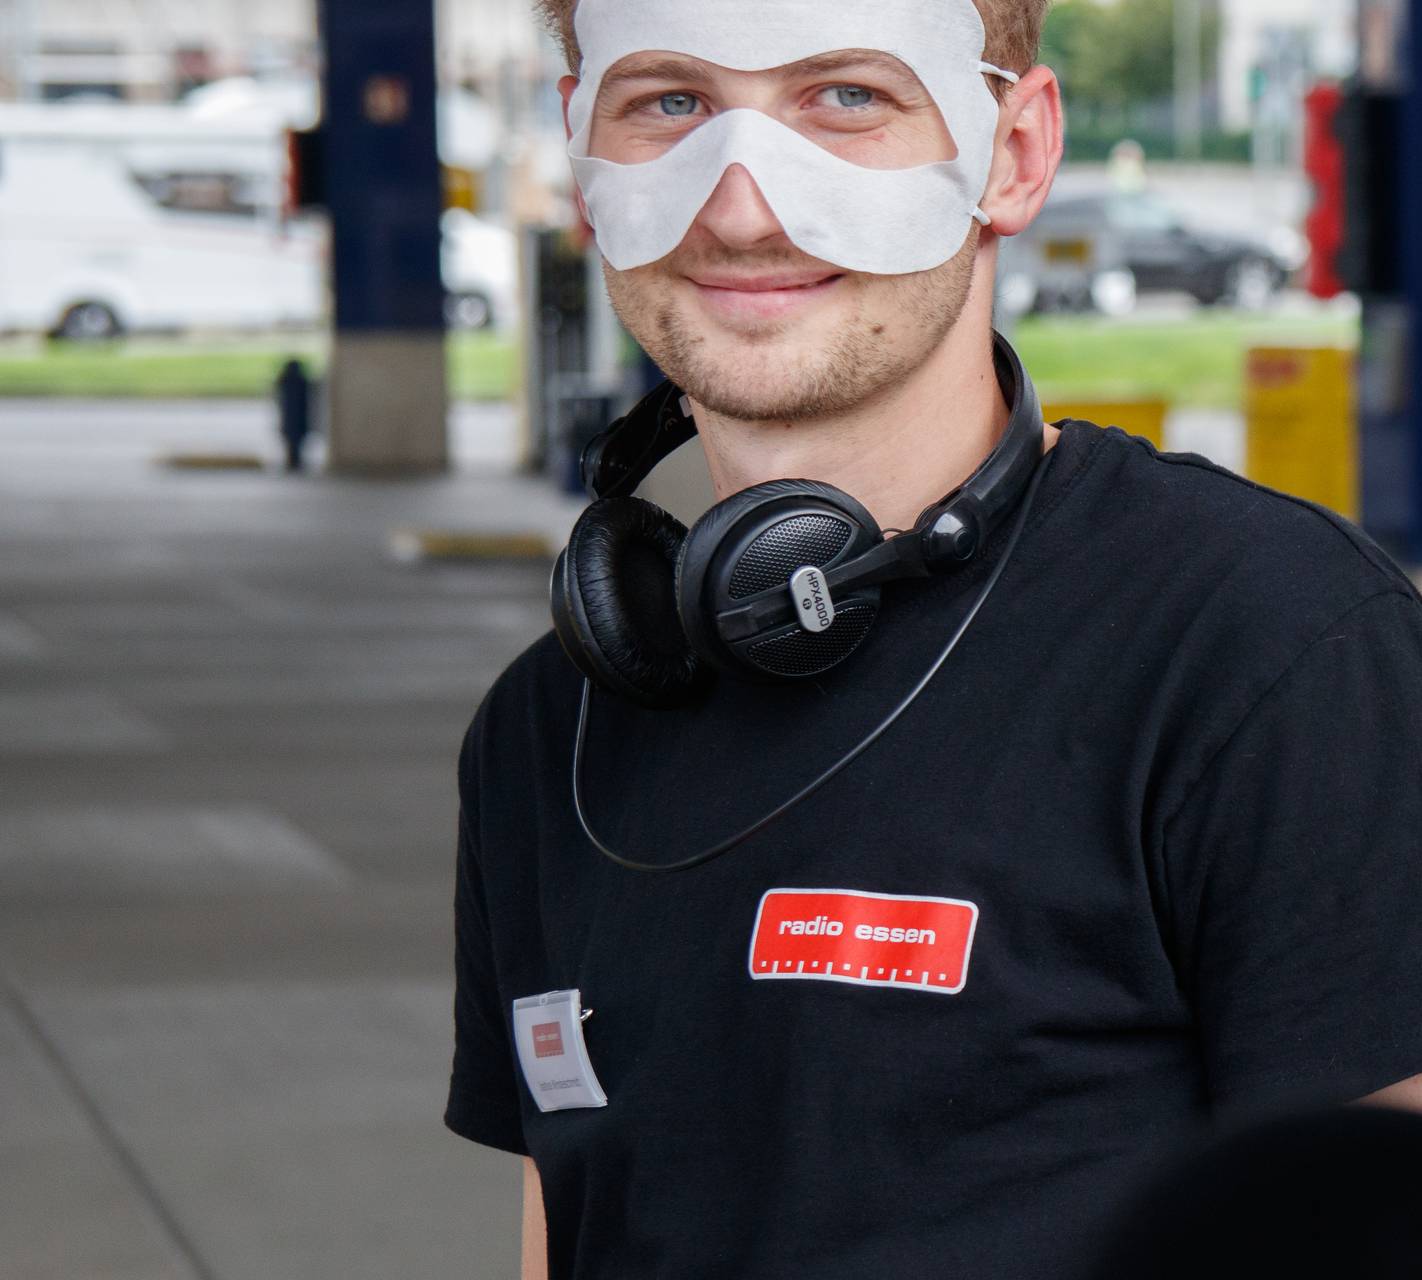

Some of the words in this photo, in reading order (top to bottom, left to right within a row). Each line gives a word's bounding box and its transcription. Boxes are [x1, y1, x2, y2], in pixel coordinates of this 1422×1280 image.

[806, 571, 830, 627] HPX4000
[779, 916, 843, 936] radio
[855, 924, 935, 944] essen
